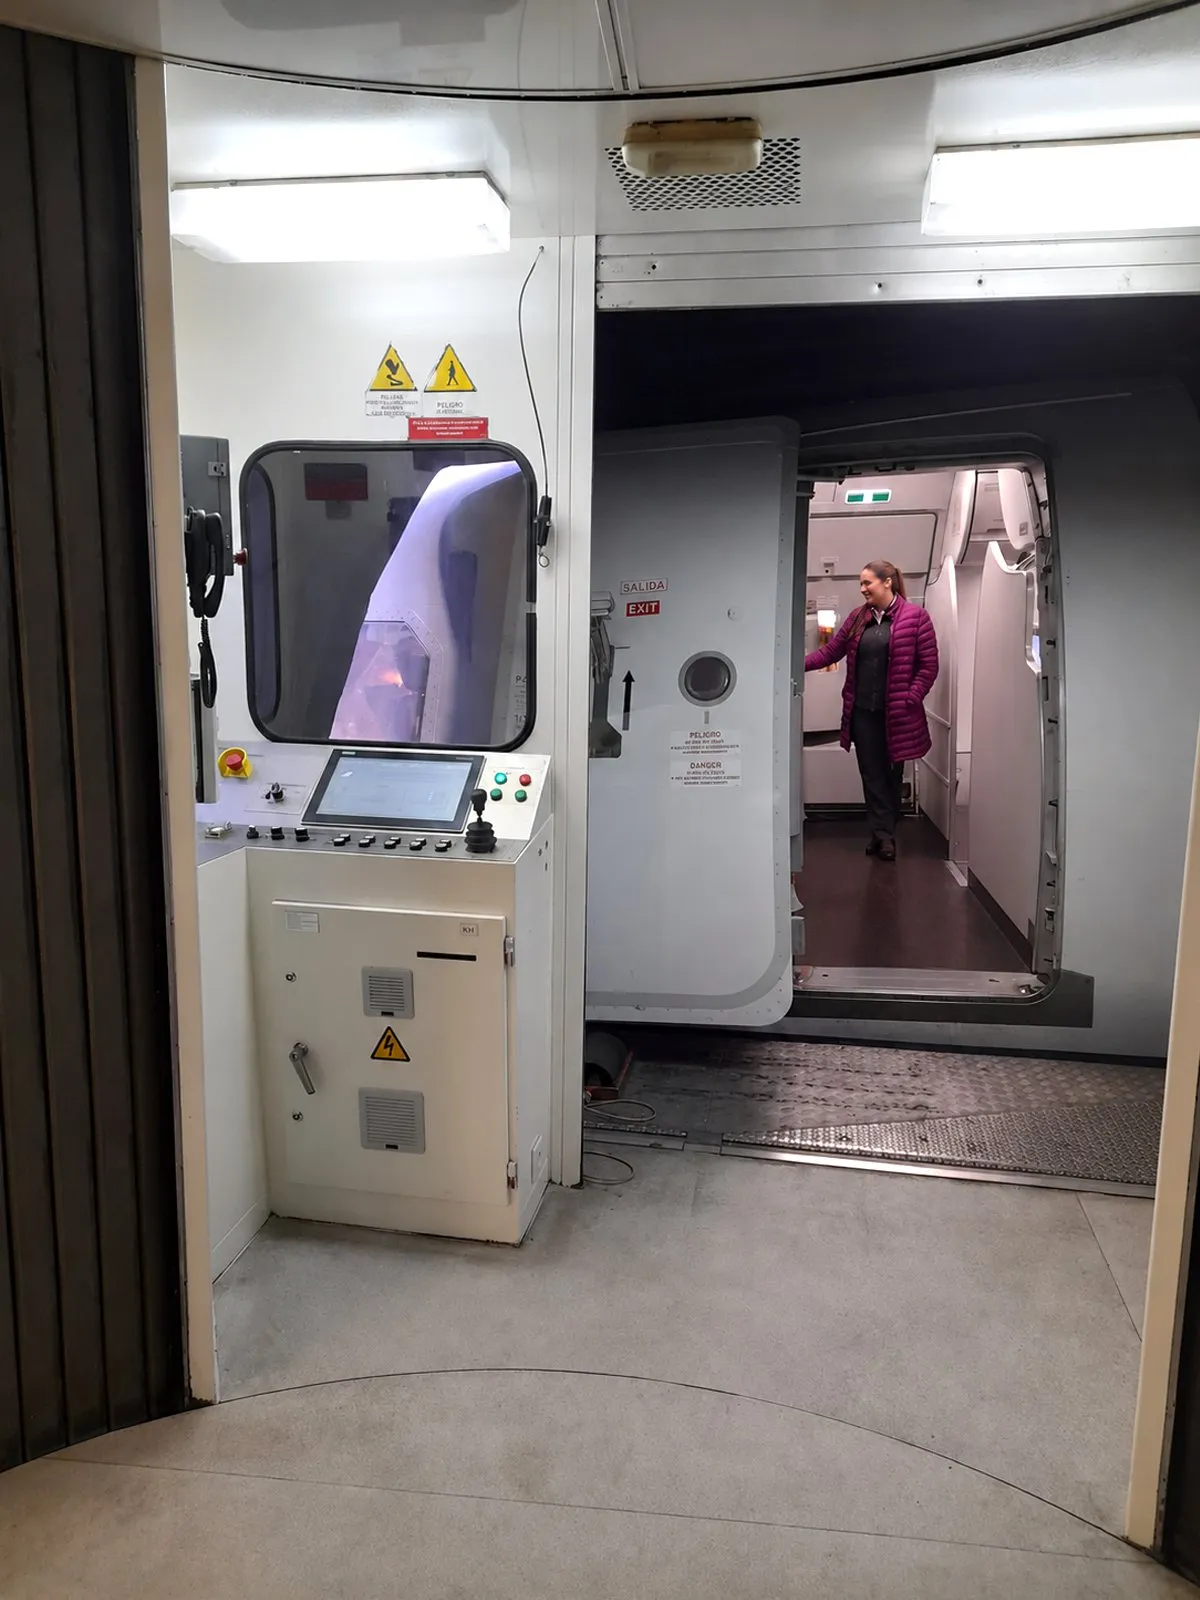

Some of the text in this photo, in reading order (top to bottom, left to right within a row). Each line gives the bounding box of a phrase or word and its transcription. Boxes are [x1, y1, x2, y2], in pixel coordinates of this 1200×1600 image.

[623, 581, 665, 593] SALIDA
[629, 602, 658, 614] EXIT
[689, 731, 721, 739] PELIGRO
